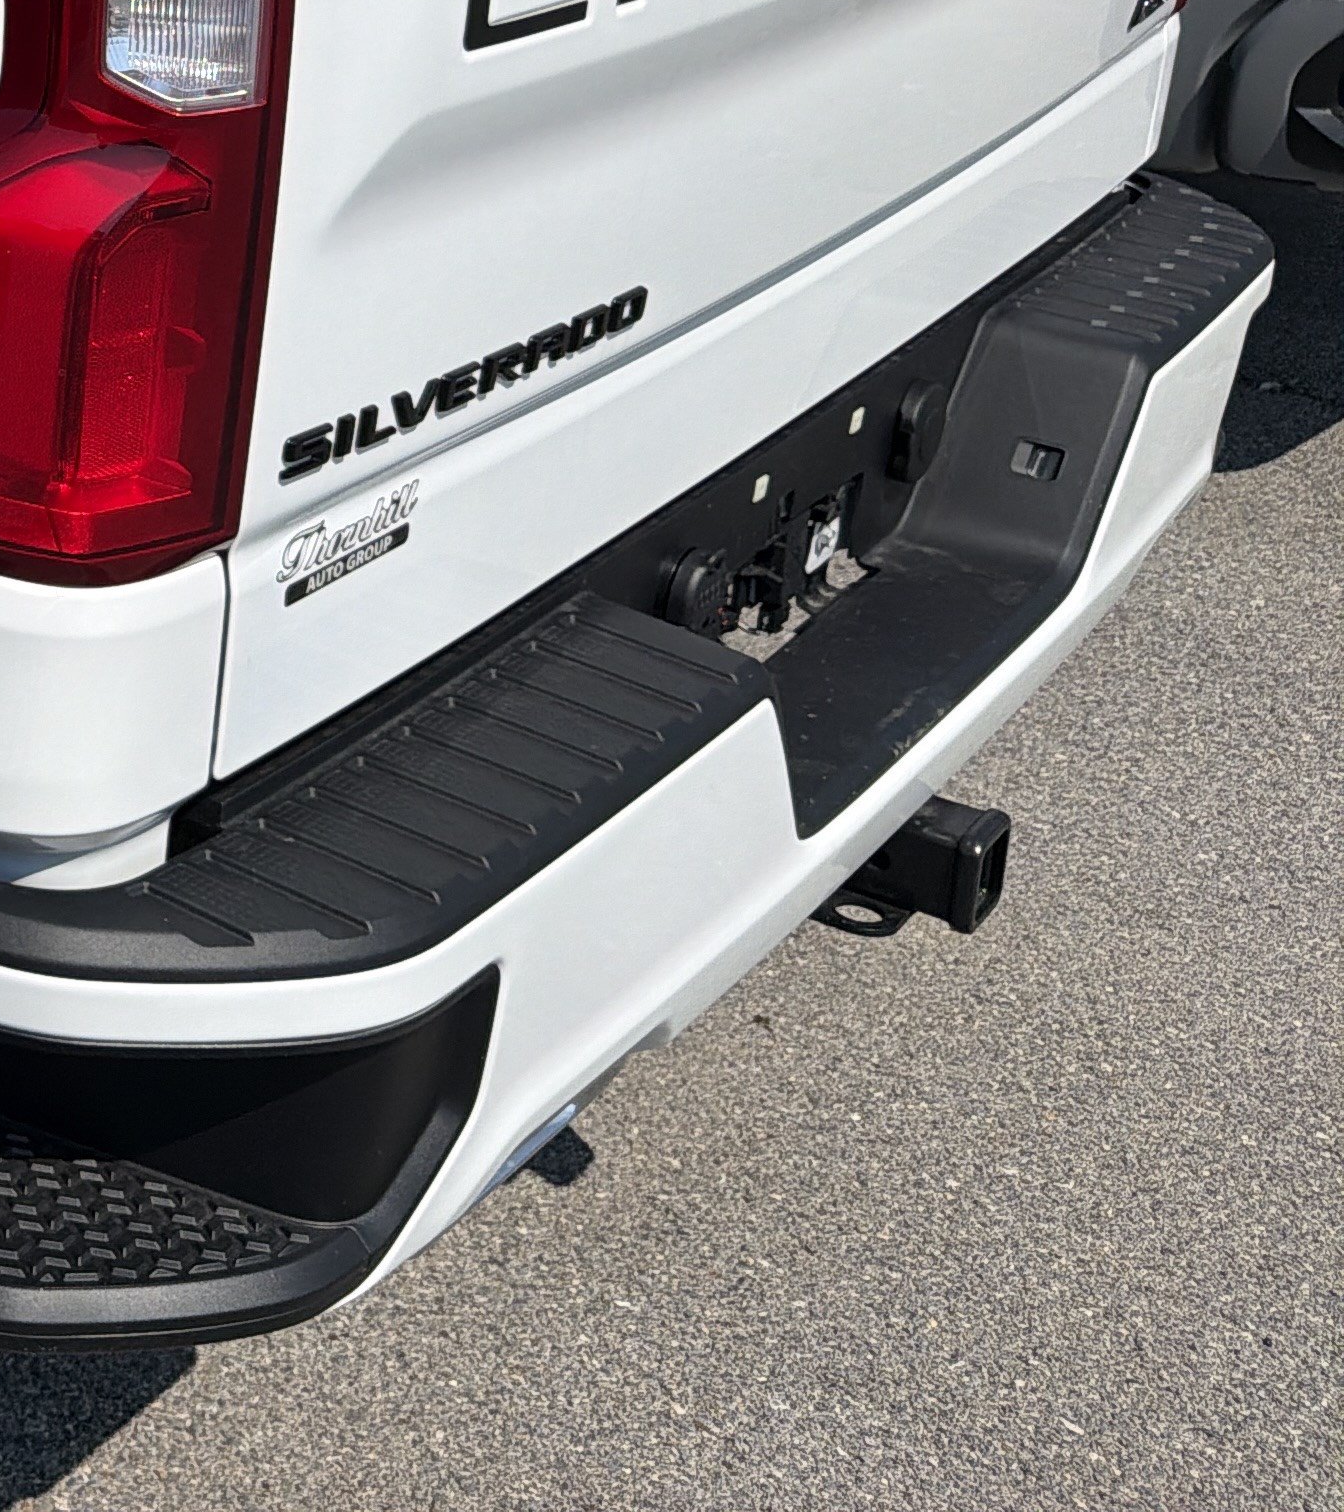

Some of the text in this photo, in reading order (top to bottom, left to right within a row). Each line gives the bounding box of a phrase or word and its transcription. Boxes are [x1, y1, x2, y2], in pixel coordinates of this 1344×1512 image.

[278, 285, 649, 484] SILVERADO
[276, 478, 420, 583] Thornhill
[305, 535, 393, 594] AUTO GROUP
